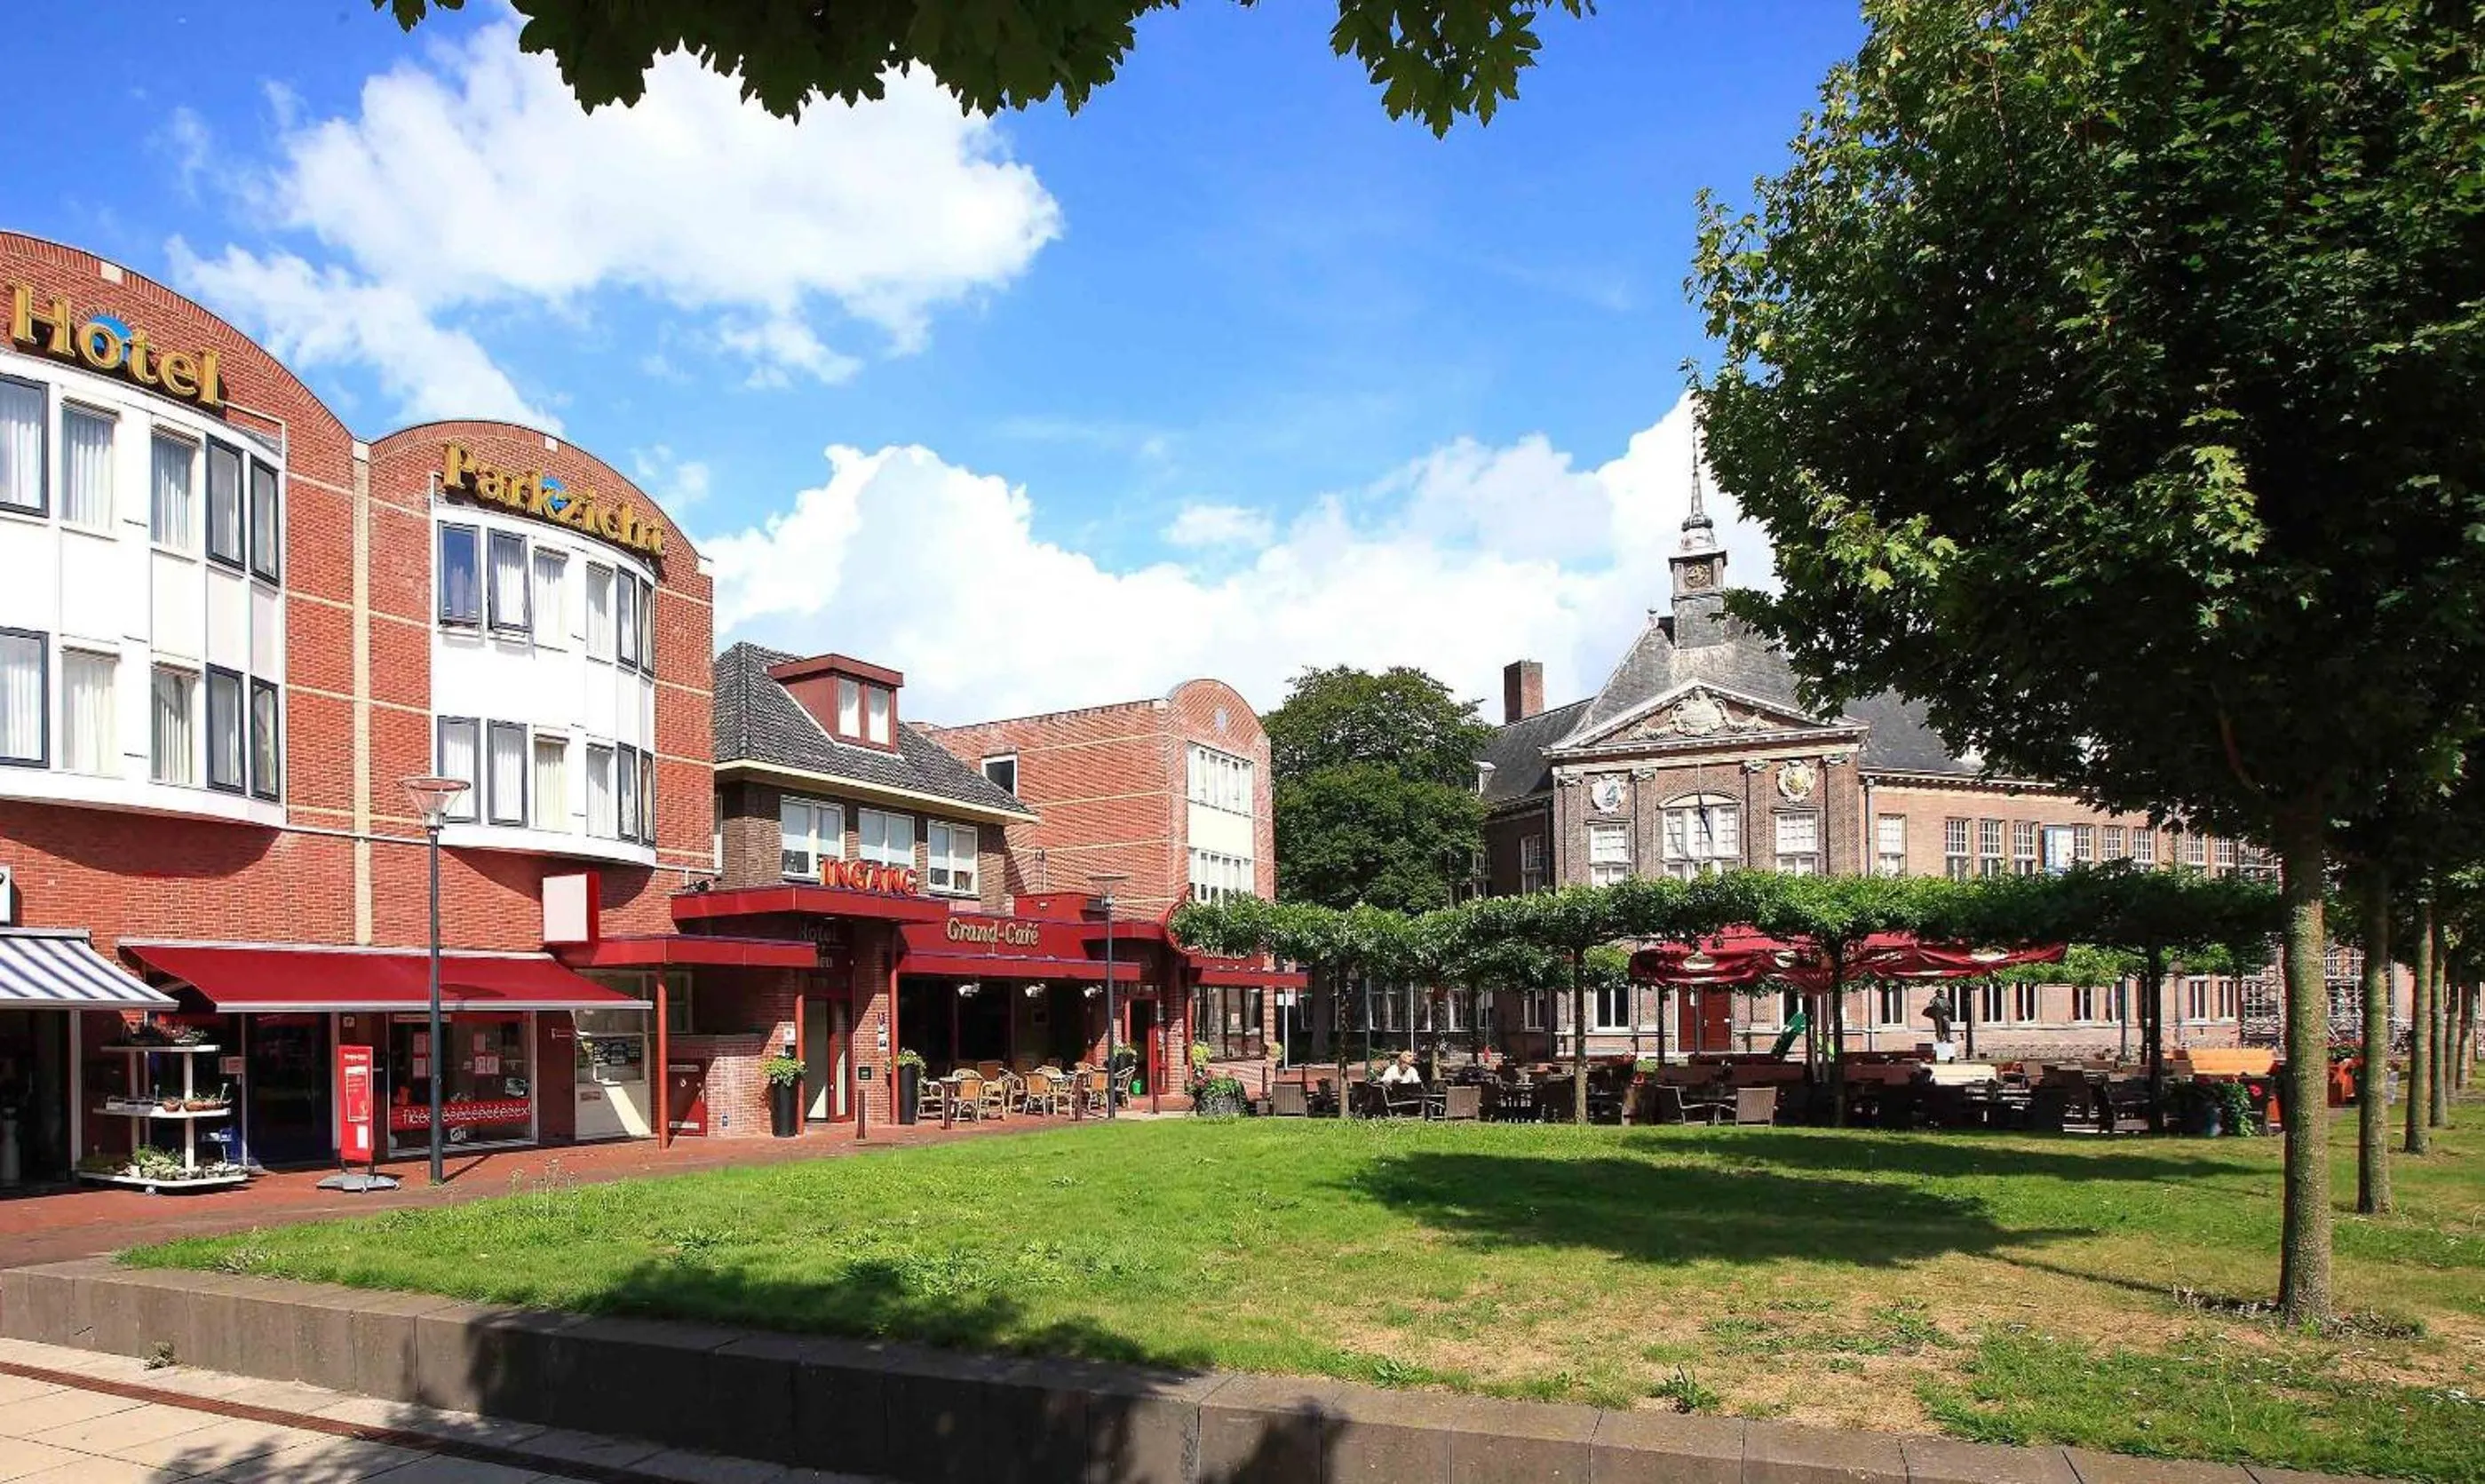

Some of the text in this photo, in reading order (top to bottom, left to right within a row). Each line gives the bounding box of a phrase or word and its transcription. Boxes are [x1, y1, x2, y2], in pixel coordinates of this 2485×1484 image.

[9, 279, 221, 406] Hotel
[444, 437, 665, 554] Parkzicht
[820, 859, 917, 895] INGANG
[947, 917, 1038, 945] Grand-Café
